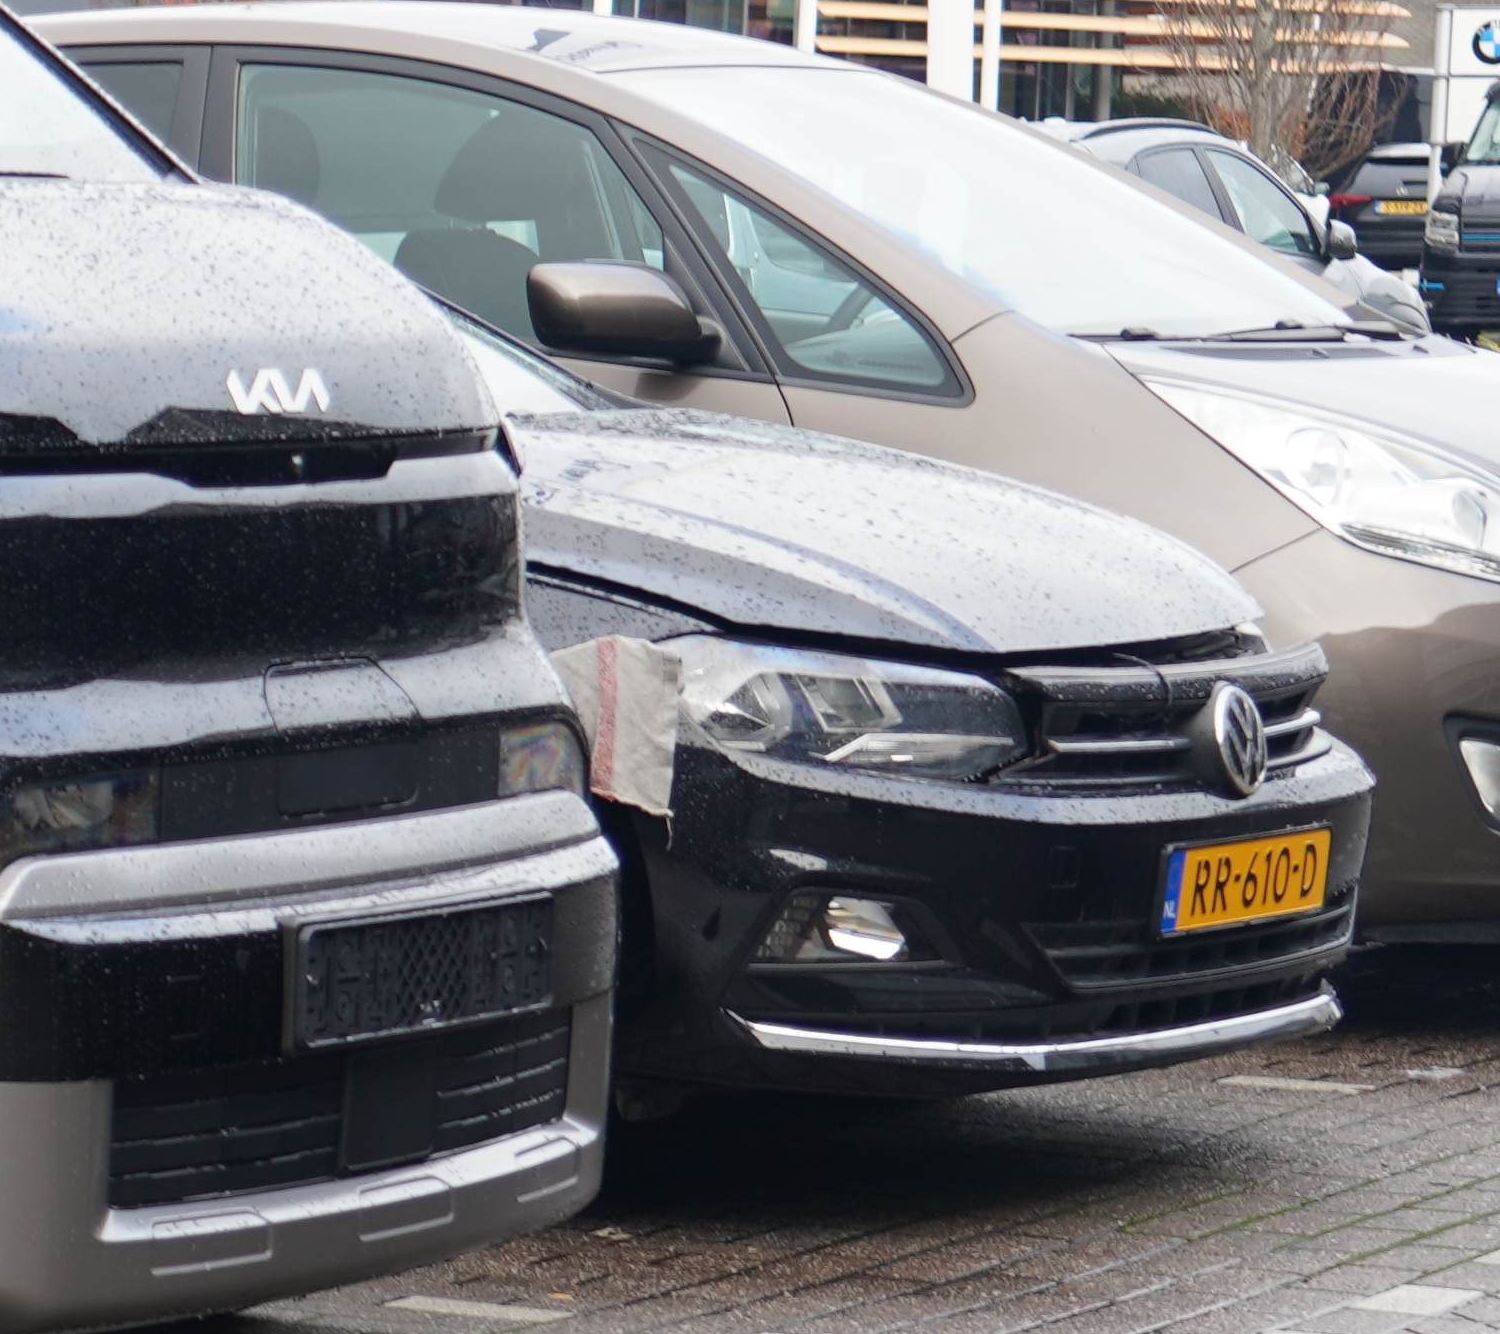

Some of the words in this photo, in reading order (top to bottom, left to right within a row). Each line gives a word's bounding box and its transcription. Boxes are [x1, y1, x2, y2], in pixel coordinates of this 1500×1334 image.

[226, 367, 331, 415] KIA
[1190, 843, 1318, 919] RR-610-D
[1163, 899, 1177, 920] NL
